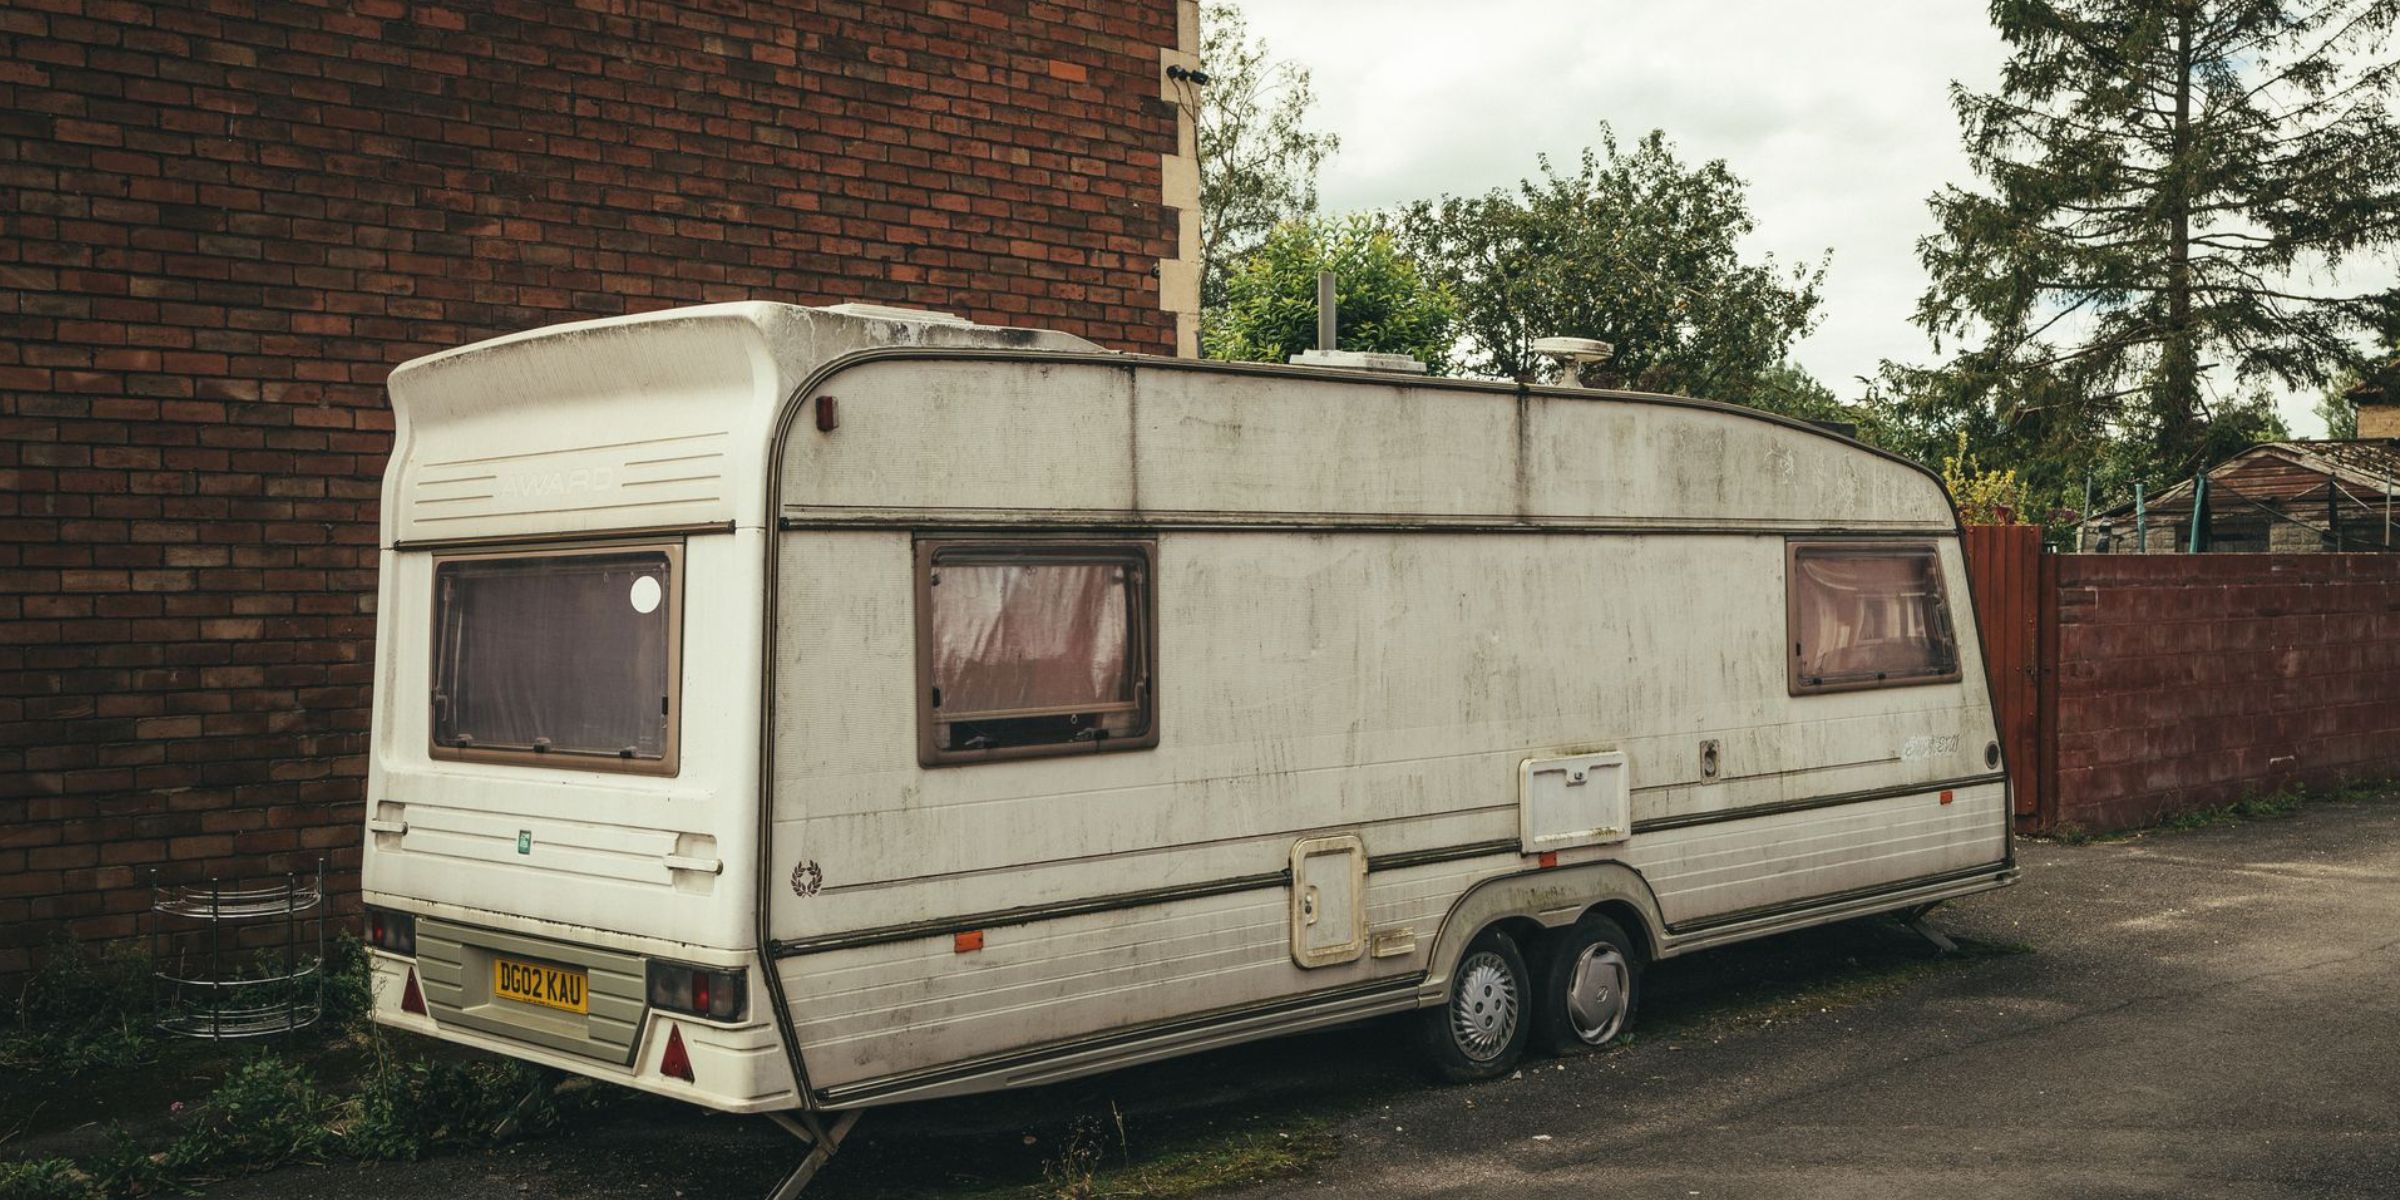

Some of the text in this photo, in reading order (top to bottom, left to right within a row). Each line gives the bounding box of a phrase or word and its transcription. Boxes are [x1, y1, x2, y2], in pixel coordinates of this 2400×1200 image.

[501, 466, 614, 497] AWARD
[501, 961, 581, 1005] DG02 KAU
